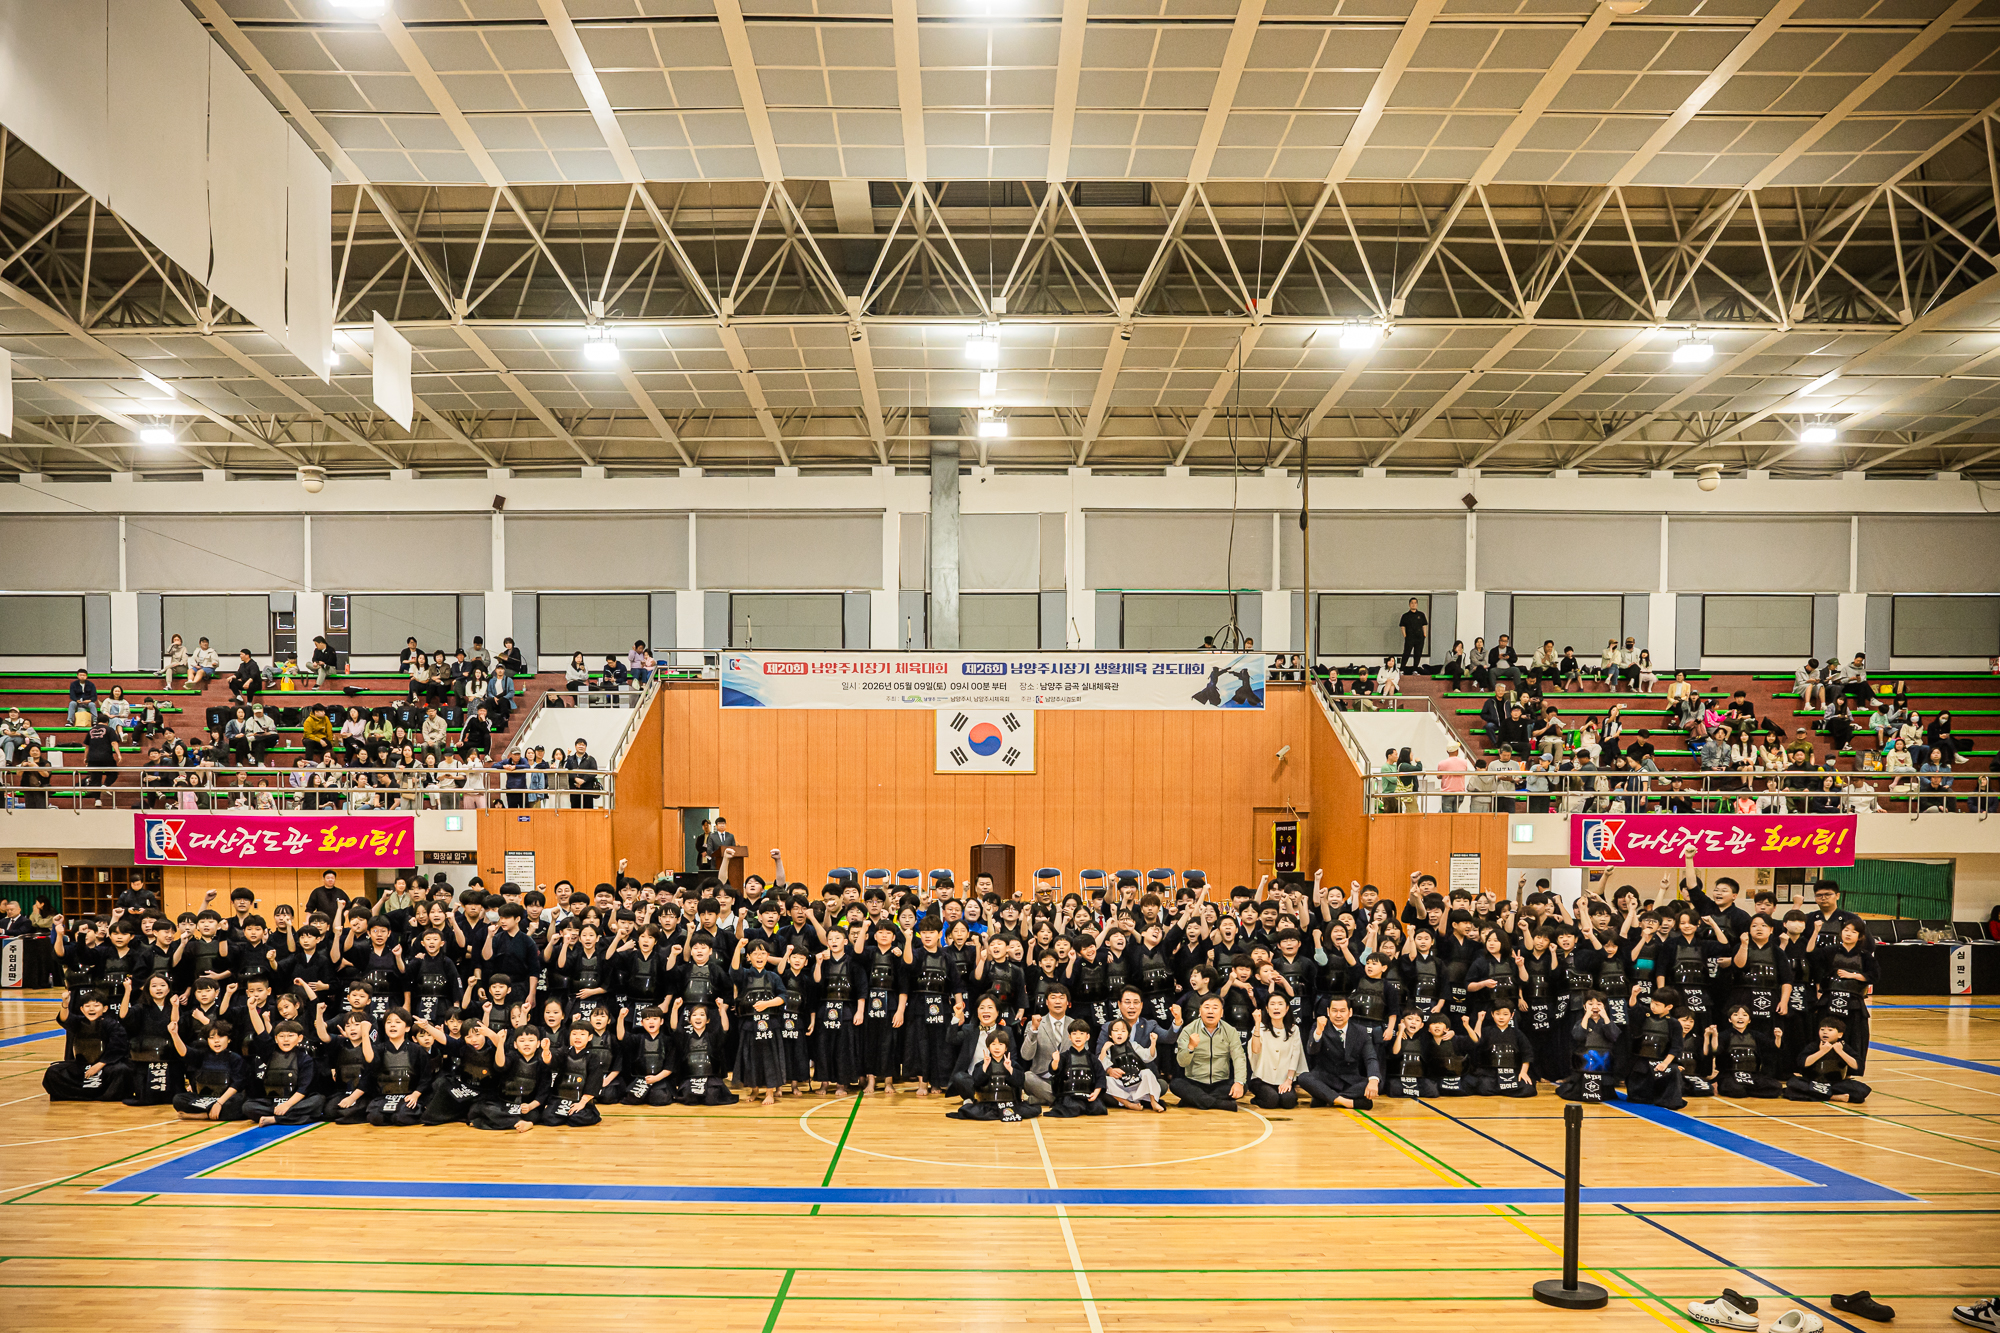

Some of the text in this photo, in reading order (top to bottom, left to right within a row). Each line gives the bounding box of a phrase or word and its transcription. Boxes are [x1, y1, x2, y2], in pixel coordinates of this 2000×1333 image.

[765, 662, 948, 675] 제20회 남양주시장기 체육대회
[964, 662, 1206, 676] 제26회 남양주시장기 생활체육 검도대회
[841, 682, 857, 690] 일시
[862, 682, 892, 690] 2026년
[893, 682, 912, 690] 05월
[914, 682, 946, 691] 09일(토)
[950, 682, 969, 690] 09시
[970, 682, 990, 690] 00분
[992, 682, 1007, 691] 부터
[1019, 682, 1034, 691] 장소
[1040, 682, 1063, 691] 남양주
[1064, 682, 1080, 691] 금곡
[1081, 682, 1119, 691] 실내체육관
[188, 824, 407, 859] 다산검도관 화이팅!
[1627, 824, 1849, 859] 다산검도관 화이팅!
[454, 852, 467, 861] 입구
[8, 944, 17, 981] 주임심판
[1956, 951, 1966, 988] 심판석
[1694, 1313, 1721, 1325] crocs
